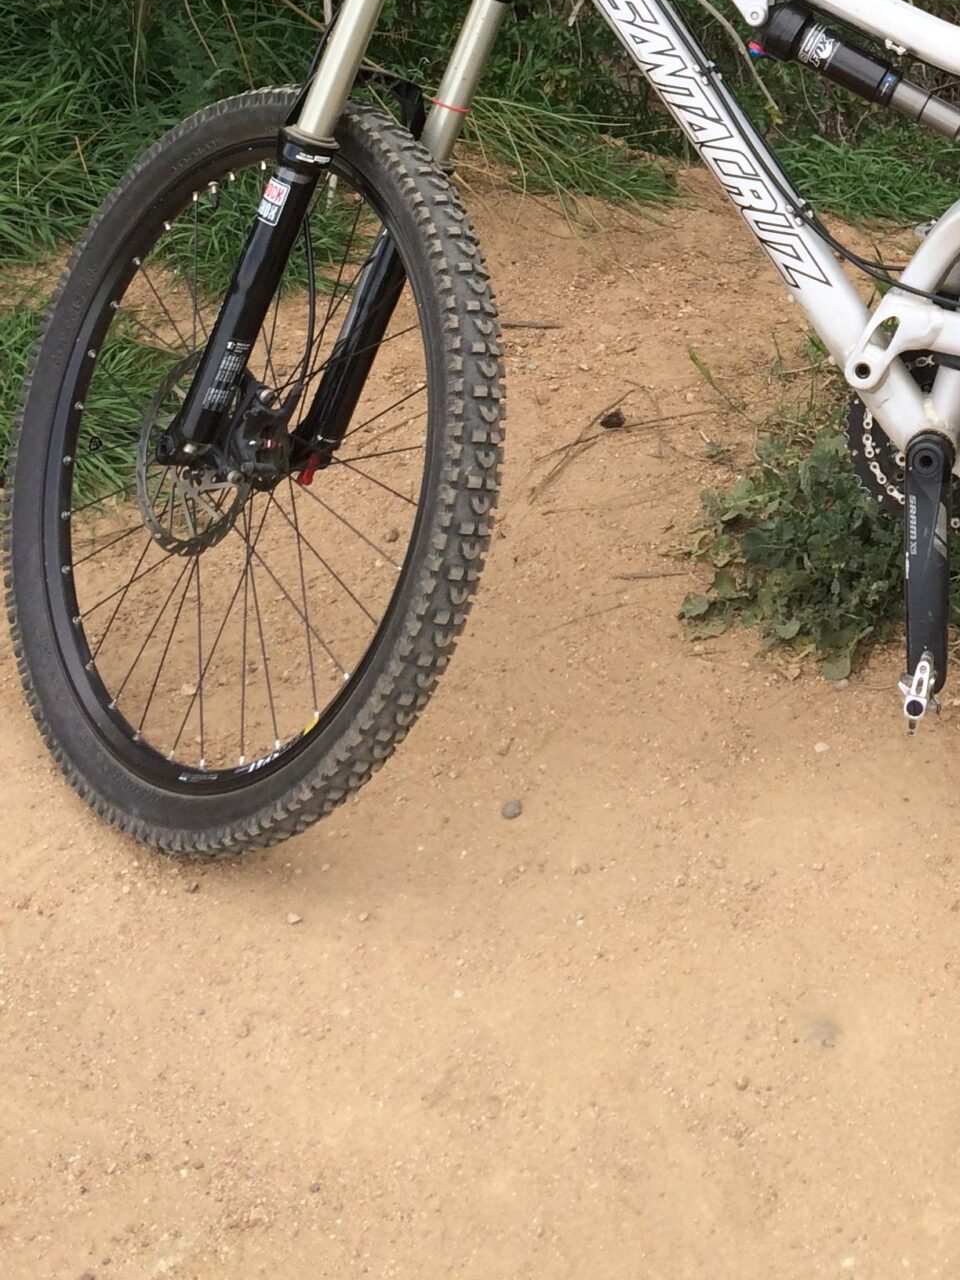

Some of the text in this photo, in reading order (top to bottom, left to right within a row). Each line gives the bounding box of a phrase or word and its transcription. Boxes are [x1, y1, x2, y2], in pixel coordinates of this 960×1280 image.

[808, 33, 836, 68] FOX
[266, 183, 285, 203] OCK
[909, 494, 918, 540] SRAM
